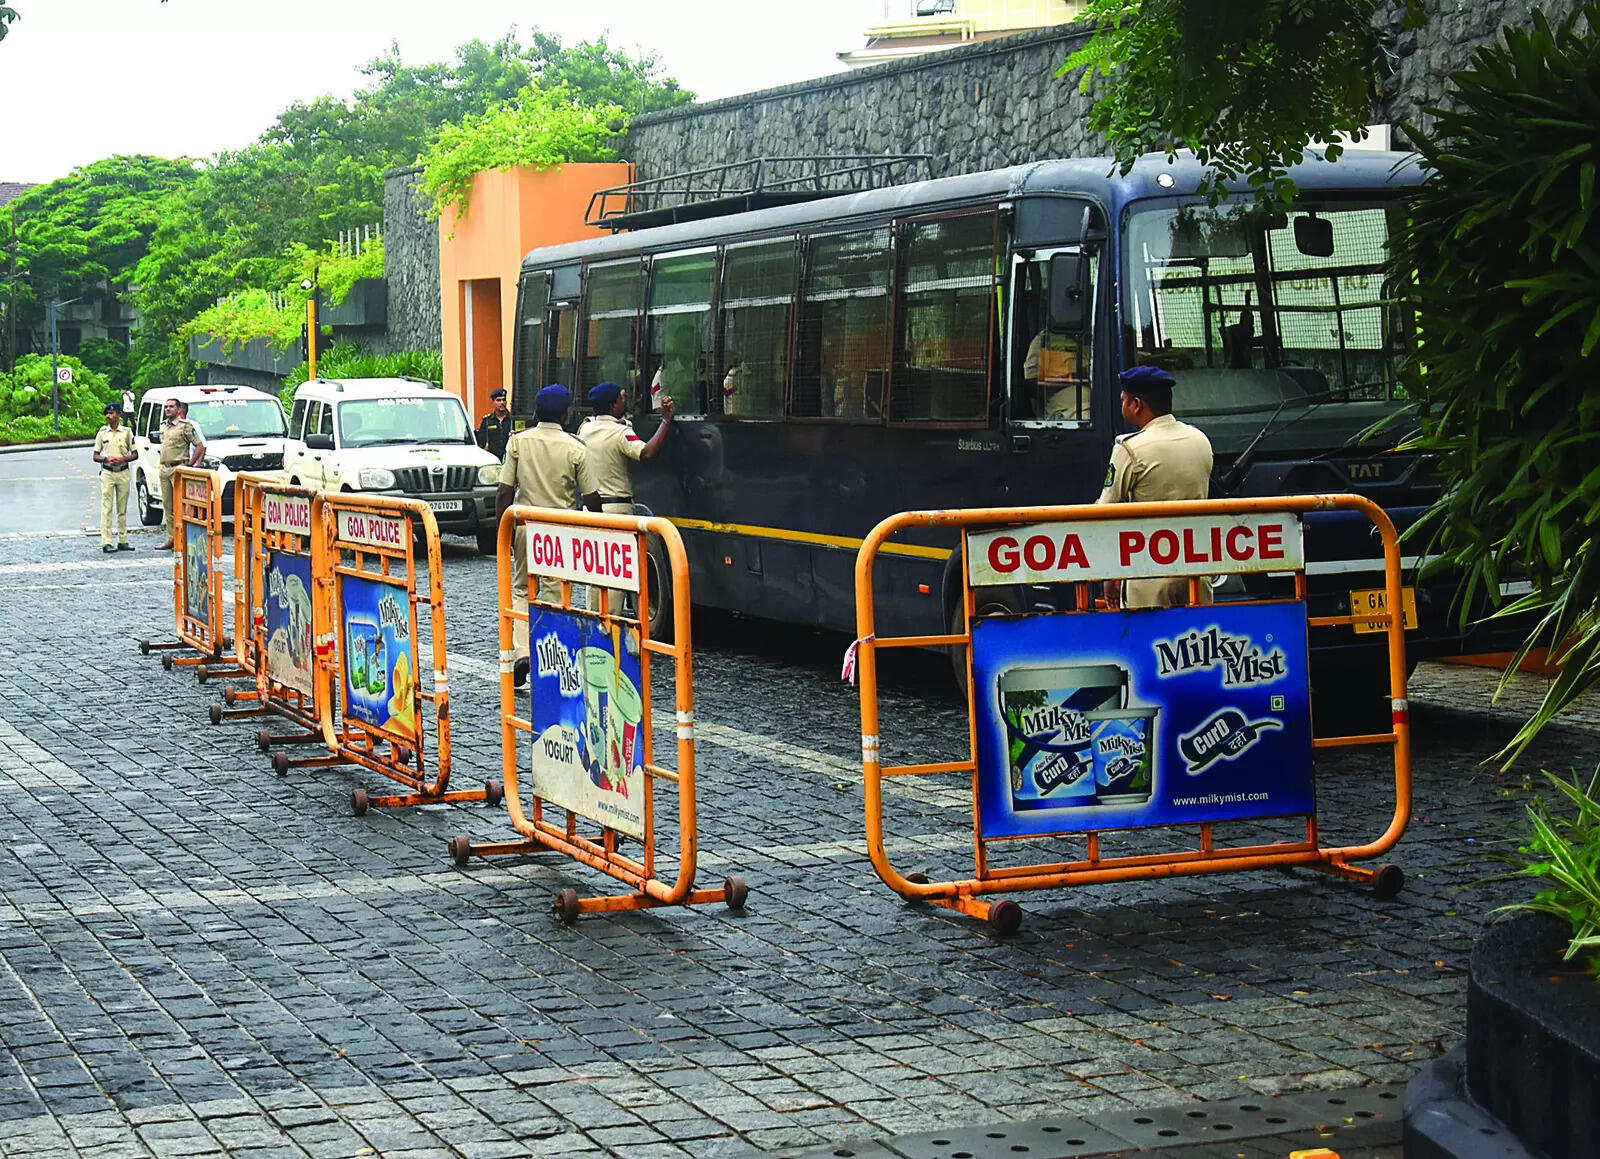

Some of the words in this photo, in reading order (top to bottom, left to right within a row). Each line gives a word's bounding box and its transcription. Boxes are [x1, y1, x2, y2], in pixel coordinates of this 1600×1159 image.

[267, 501, 282, 525] GOA
[284, 503, 309, 528] POLICE
[347, 516, 366, 539] GOA
[369, 519, 400, 544] POLICE
[533, 532, 564, 568] GOA
[572, 537, 633, 579] POLICE
[987, 533, 1090, 573] GOA
[1119, 524, 1285, 567] POLICE
[1368, 592, 1388, 609] GA
[538, 637, 567, 672] Milky
[560, 662, 581, 692] Mist
[1155, 628, 1248, 675] Milky
[1223, 647, 1285, 685] Mist
[561, 729, 574, 743] FRUIT
[1023, 705, 1079, 736] Milky
[1063, 712, 1091, 742] Mis
[543, 737, 574, 765] YOGURT
[1099, 735, 1131, 754] Milky
[1122, 742, 1144, 757] Mist
[1172, 791, 1269, 806] www.milkymist.com
